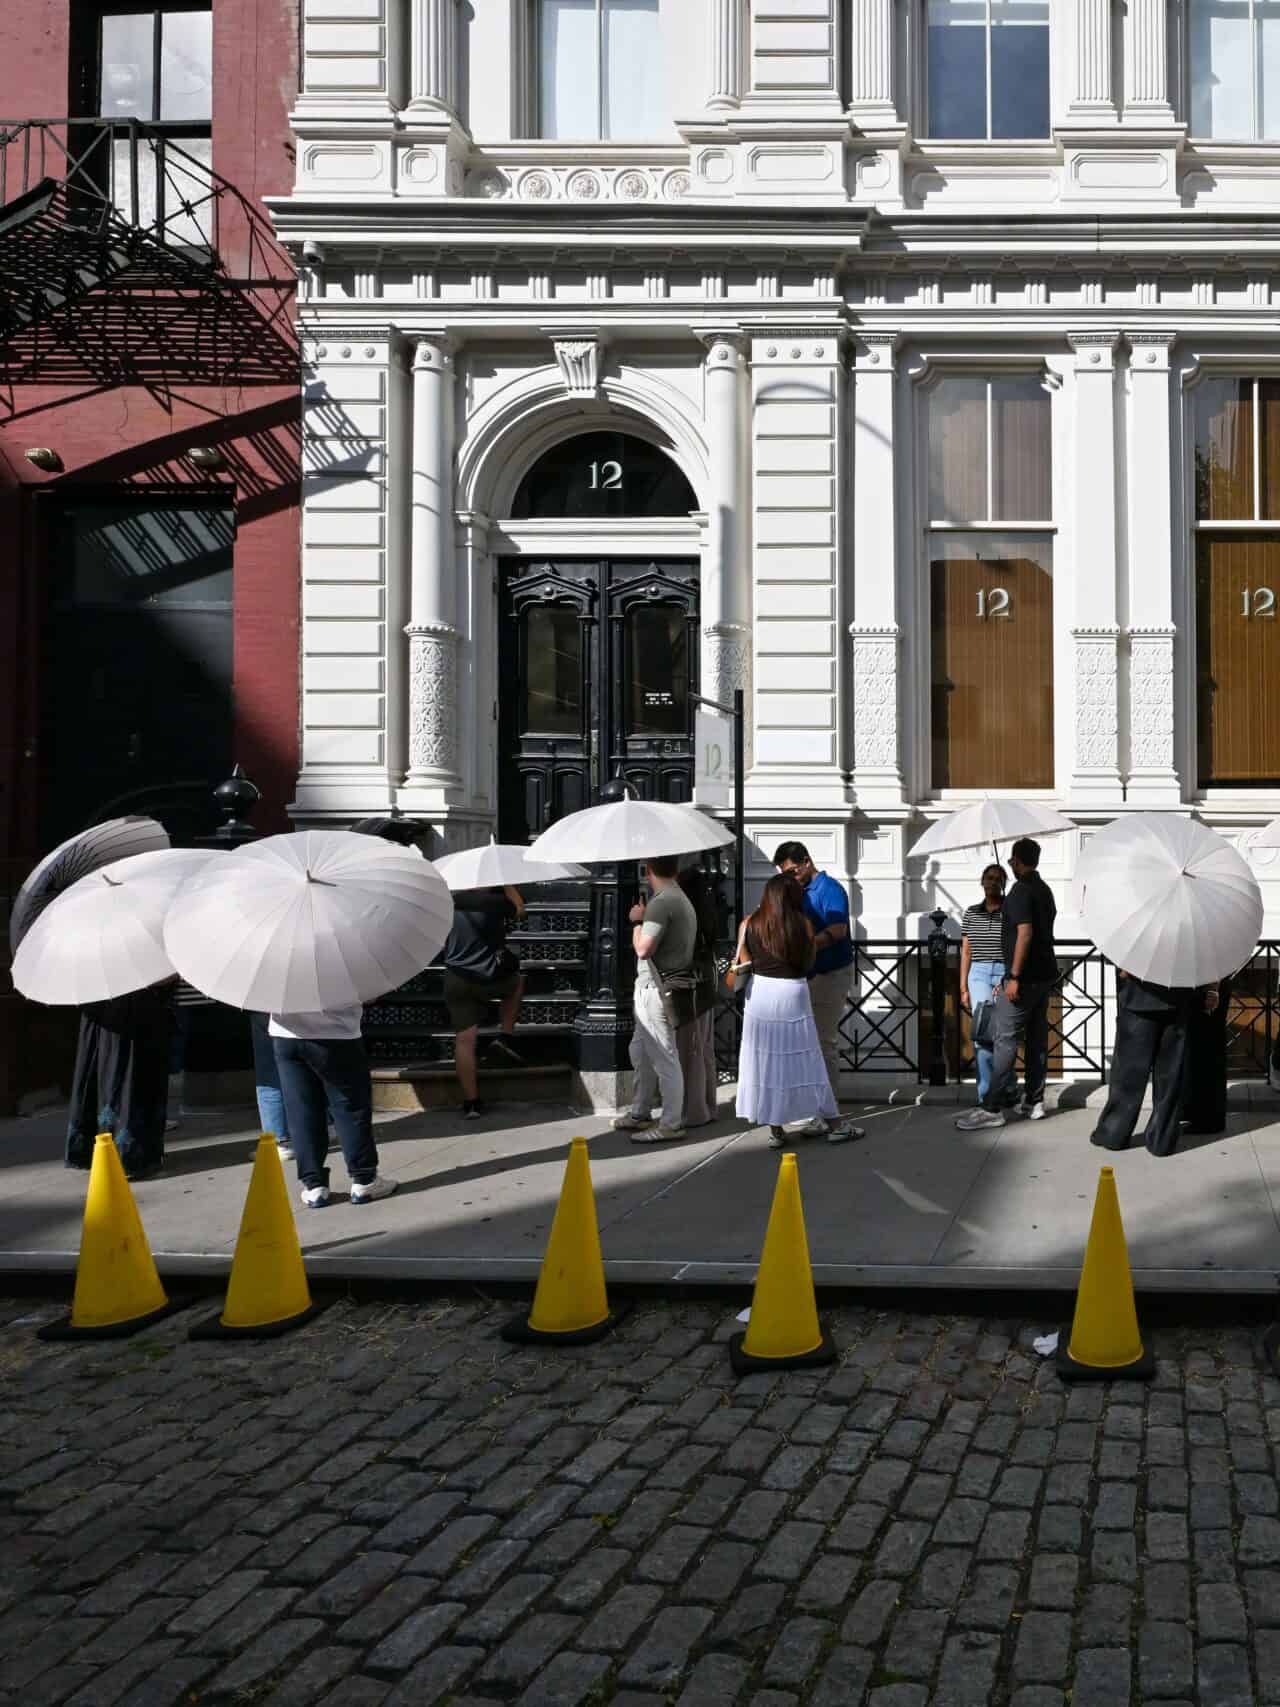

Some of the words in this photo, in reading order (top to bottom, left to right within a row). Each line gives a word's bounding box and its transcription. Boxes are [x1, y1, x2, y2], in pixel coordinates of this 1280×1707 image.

[587, 460, 623, 489] 12
[975, 587, 1009, 617] 12
[1240, 587, 1275, 617] 12
[703, 743, 723, 780] 12
